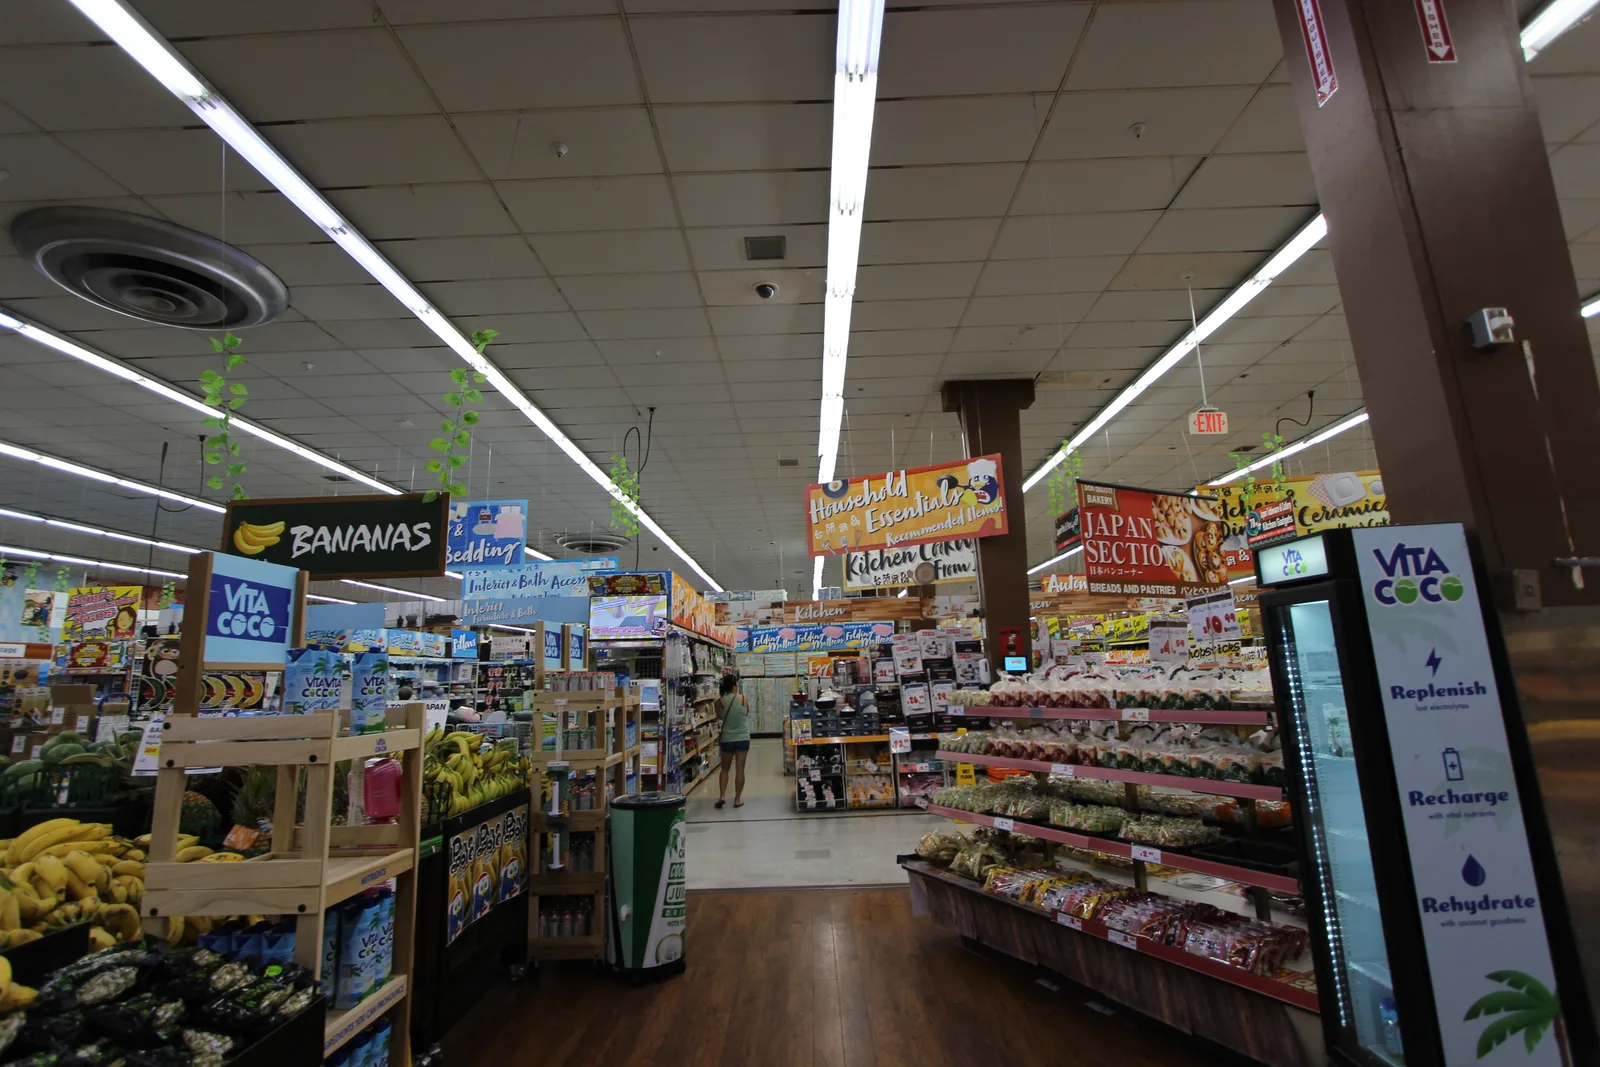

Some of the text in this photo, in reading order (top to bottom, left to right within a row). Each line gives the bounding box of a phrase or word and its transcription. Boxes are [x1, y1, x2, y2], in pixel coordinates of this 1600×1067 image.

[1197, 413, 1222, 433] EXIT
[808, 469, 909, 524] Household
[865, 478, 964, 533] Essentials
[1086, 494, 1113, 506] BAKERY
[886, 511, 965, 547] Recommended
[1084, 512, 1152, 539] JAPAN
[290, 521, 431, 558] BANANAS
[1086, 539, 1178, 568] SECTION
[1282, 549, 1303, 565] VITA
[1373, 542, 1450, 577] VITA
[934, 558, 971, 580] From
[1283, 562, 1308, 577] COCO
[470, 577, 510, 594] Interior
[519, 571, 549, 590] Bath
[1090, 582, 1122, 594] BREADS
[1123, 584, 1139, 594] AND
[1140, 585, 1176, 596] PASTRIES
[1374, 576, 1464, 605] COCO
[224, 582, 270, 615] VITA
[795, 602, 846, 622] Kitchen
[217, 611, 275, 638] COCO
[846, 628, 877, 641] Folding
[451, 634, 477, 653] Pillows
[753, 634, 783, 647] Folding
[797, 631, 827, 644] Folding
[808, 660, 832, 677] Egg
[364, 676, 386, 687] VITA
[1391, 681, 1487, 701] Replenish
[302, 688, 322, 698] COC
[1408, 788, 1509, 807] Recharge
[1421, 893, 1535, 915] Rehydrate
